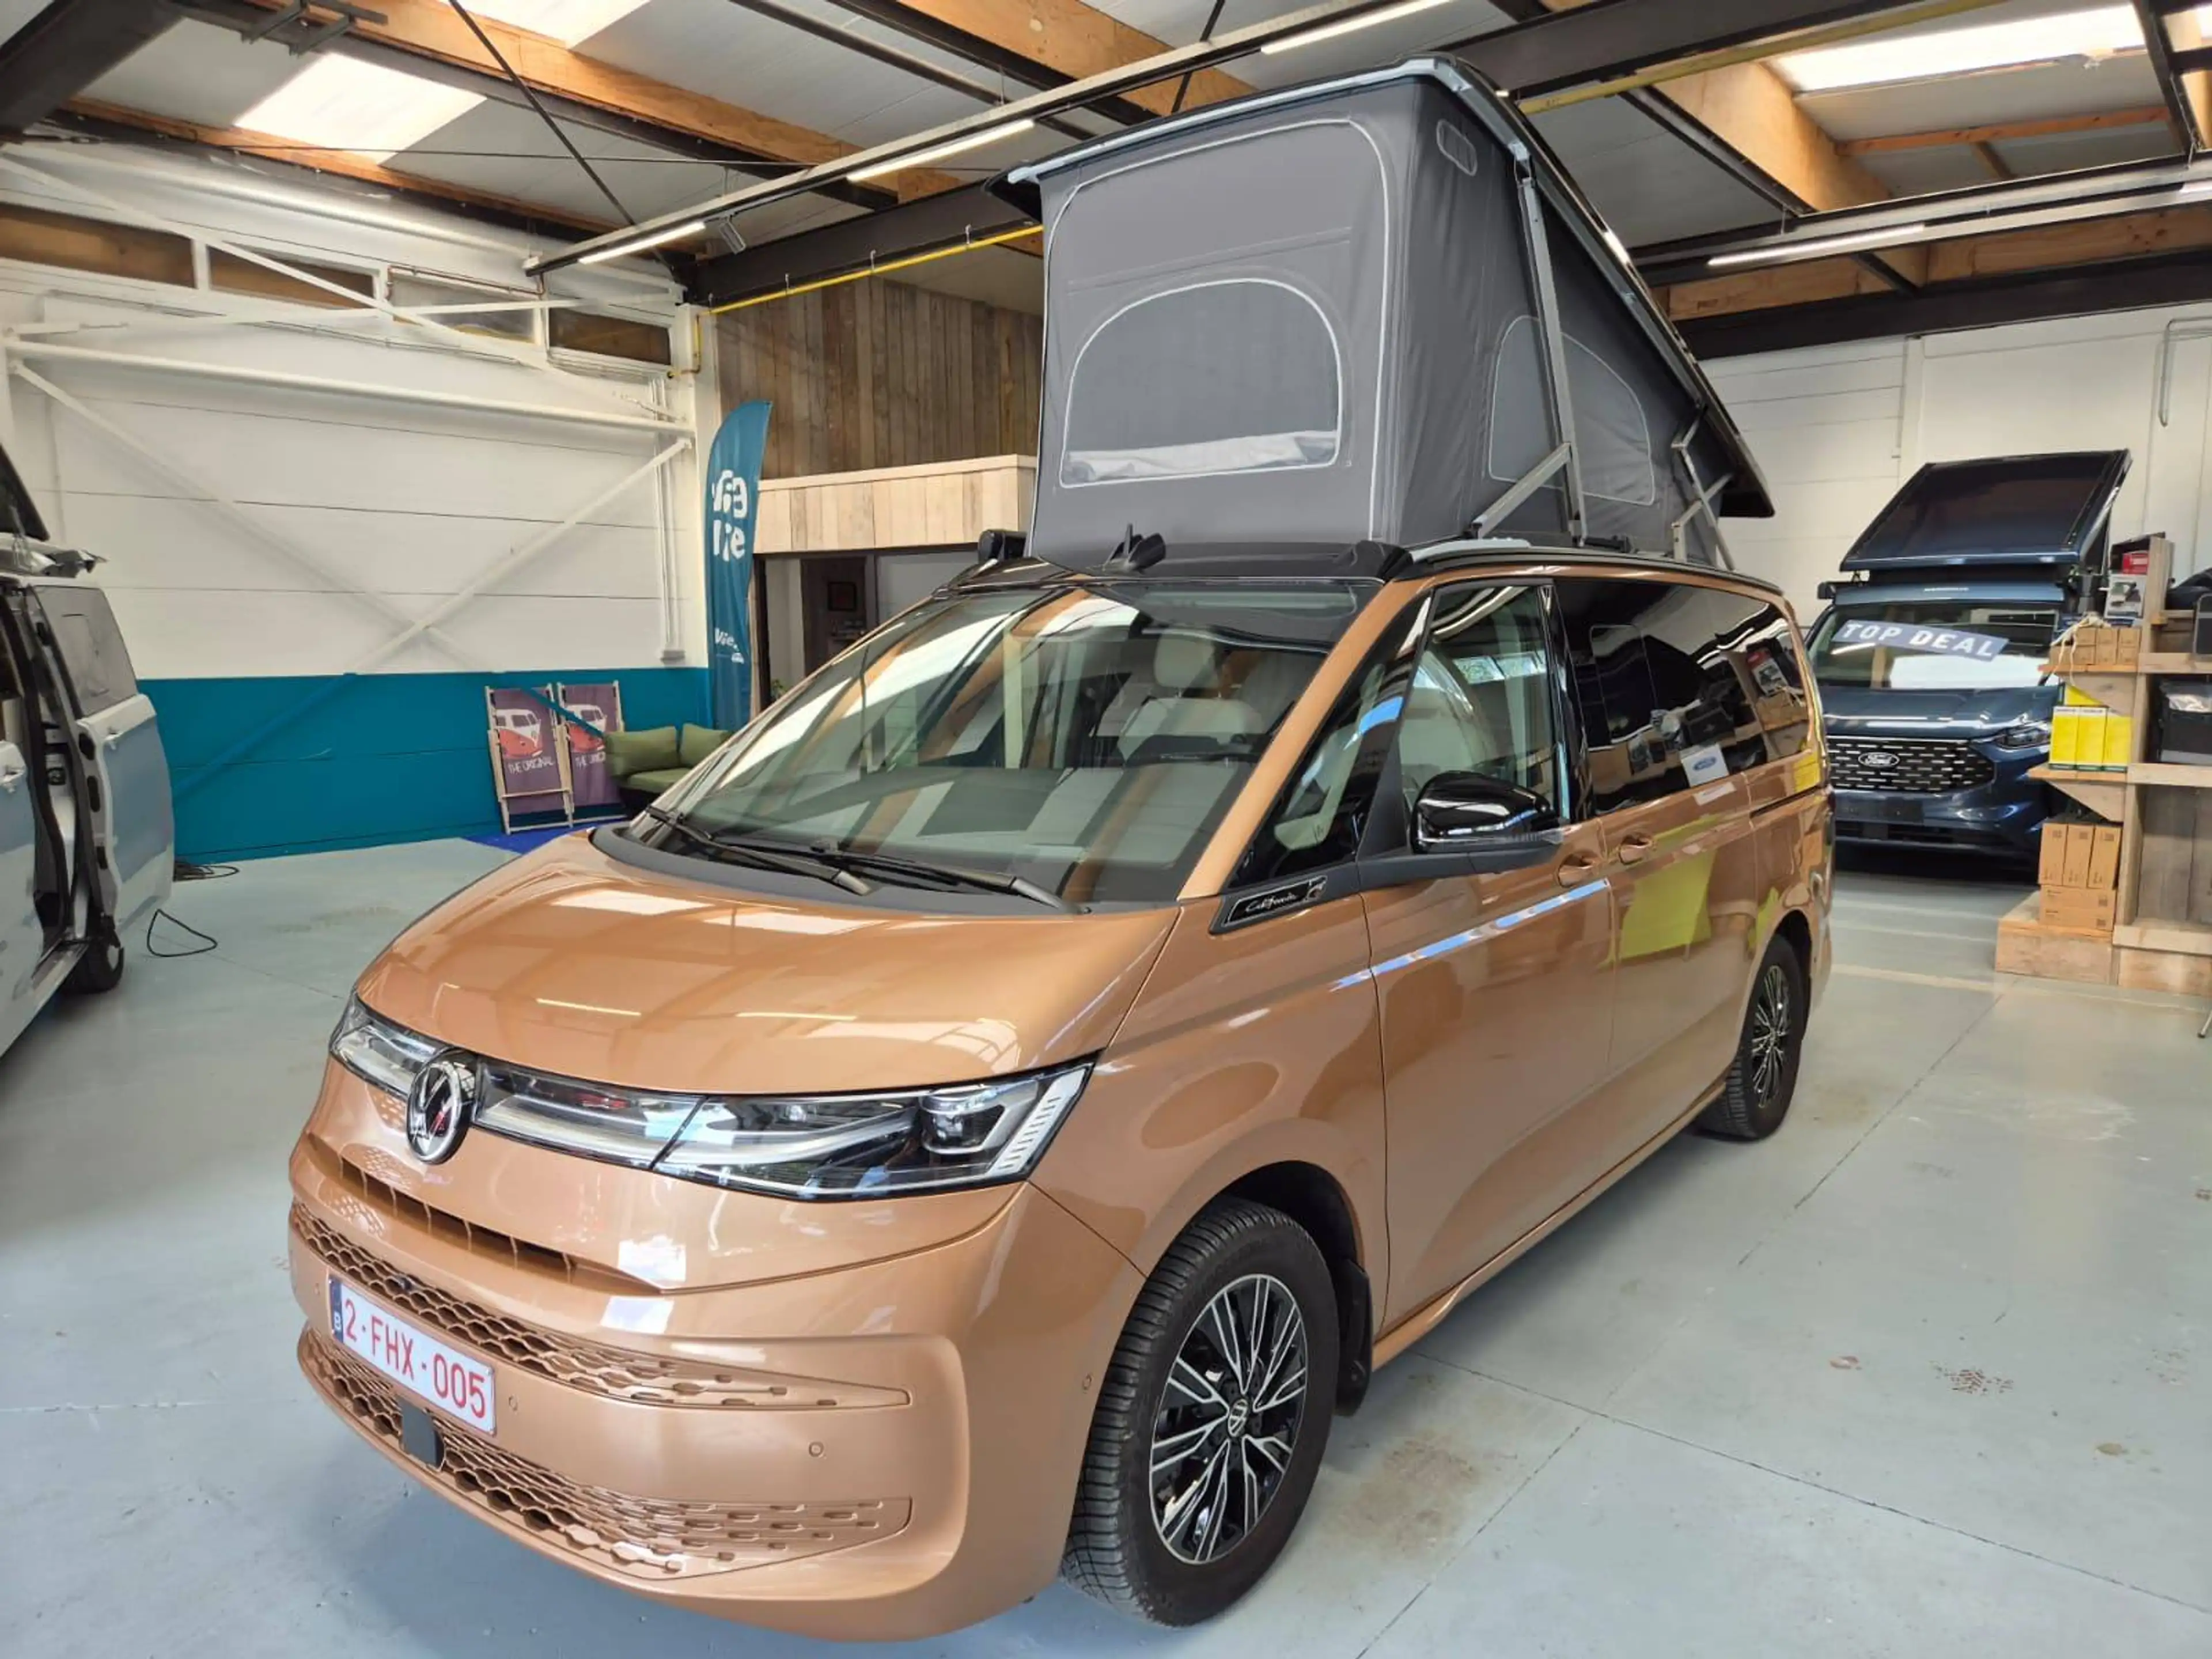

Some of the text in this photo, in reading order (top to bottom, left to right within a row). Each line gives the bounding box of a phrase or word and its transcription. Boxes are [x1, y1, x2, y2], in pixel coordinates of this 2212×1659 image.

[1842, 623, 1993, 657] TOP DEAL
[1862, 753, 1895, 766] Ford
